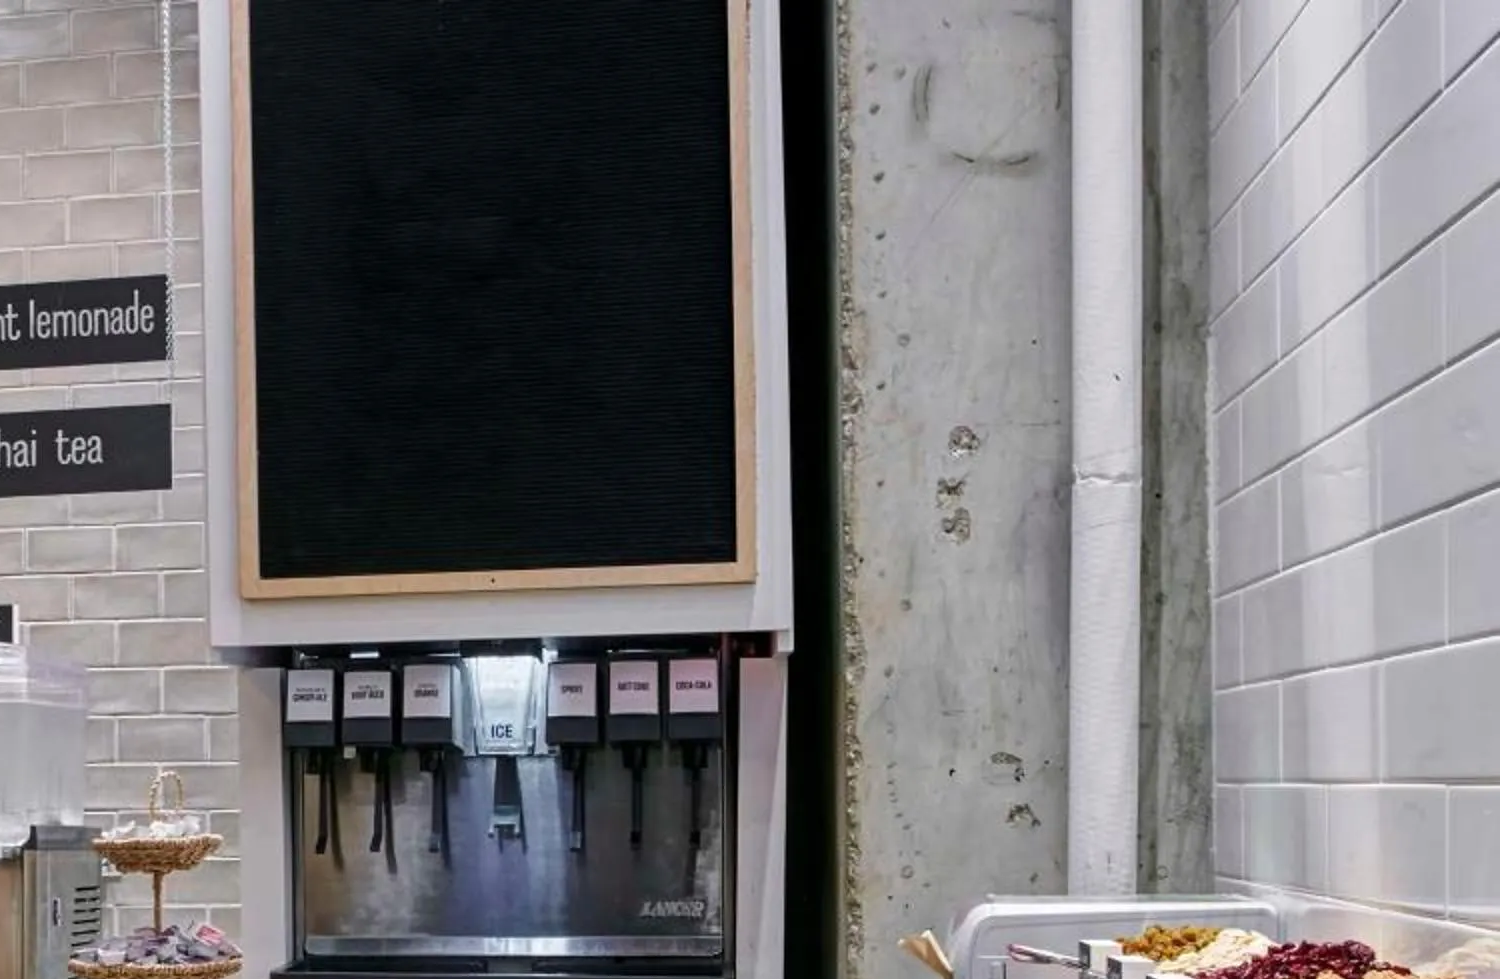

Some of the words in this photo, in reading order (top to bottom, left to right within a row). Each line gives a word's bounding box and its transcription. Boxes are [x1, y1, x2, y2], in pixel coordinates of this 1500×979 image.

[29, 288, 155, 340] lemonade
[55, 429, 104, 465] tea
[491, 724, 514, 739] ICE
